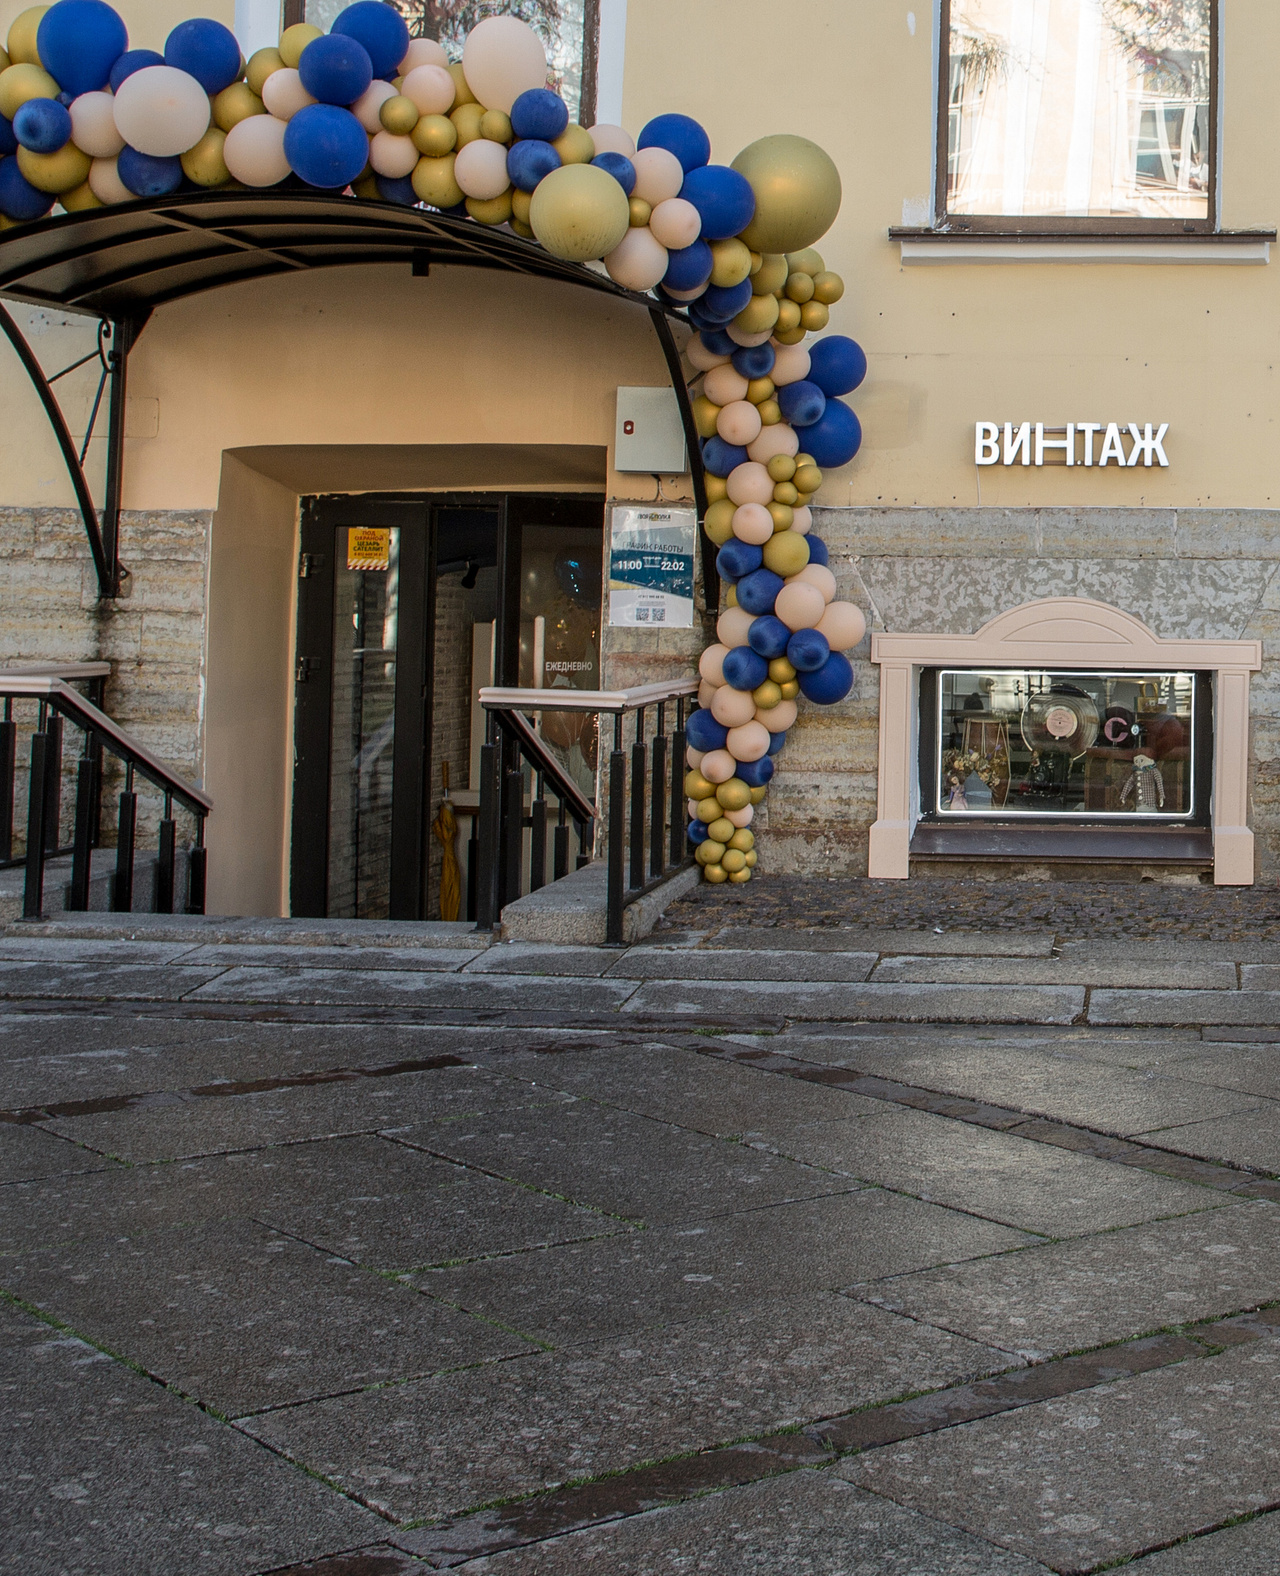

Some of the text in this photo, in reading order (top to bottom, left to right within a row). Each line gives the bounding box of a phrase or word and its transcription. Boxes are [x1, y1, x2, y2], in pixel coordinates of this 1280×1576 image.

[975, 421, 1170, 466] ВИНТАЖ
[654, 543, 684, 553] РАБОТЫ
[618, 560, 643, 570] 11:00
[545, 661, 593, 673] ЕЖЕДНЕВНО
